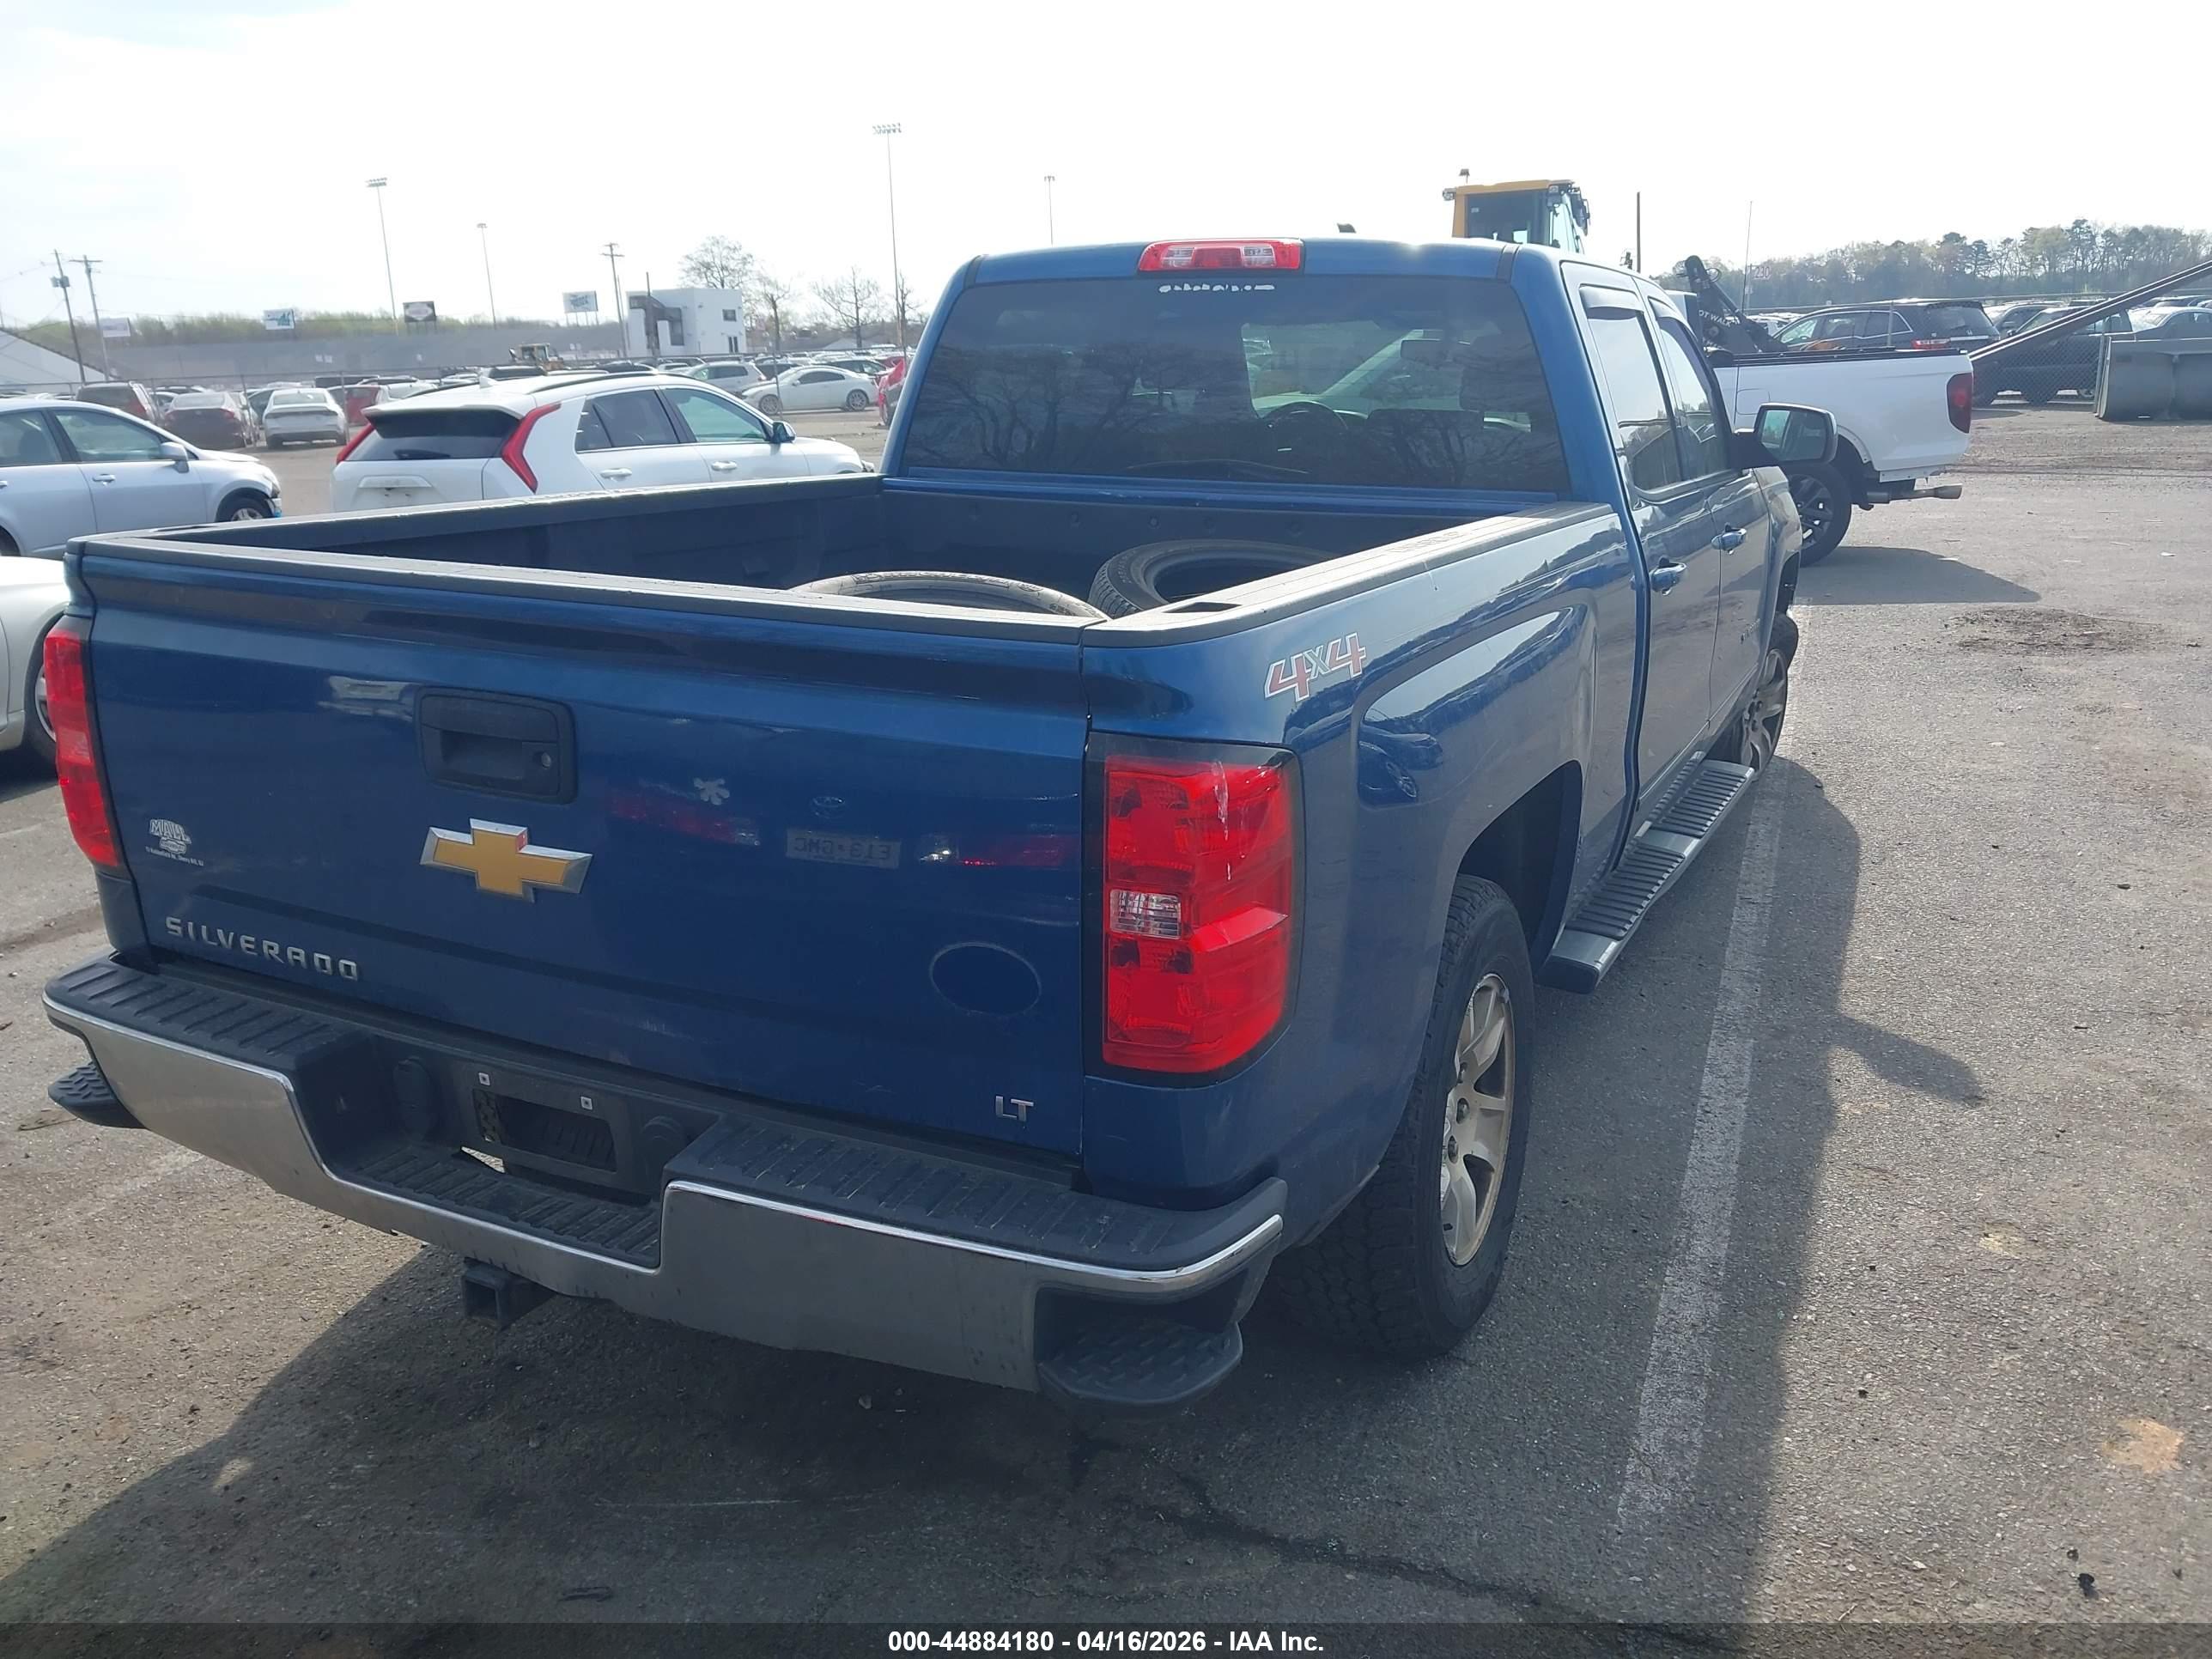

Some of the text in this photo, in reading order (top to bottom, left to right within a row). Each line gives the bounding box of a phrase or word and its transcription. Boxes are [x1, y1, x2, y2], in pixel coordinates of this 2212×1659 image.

[1711, 314, 1731, 327] WALK
[149, 818, 192, 844] MALL
[166, 916, 358, 981] SILVERADO
[995, 1096, 1035, 1121] LT
